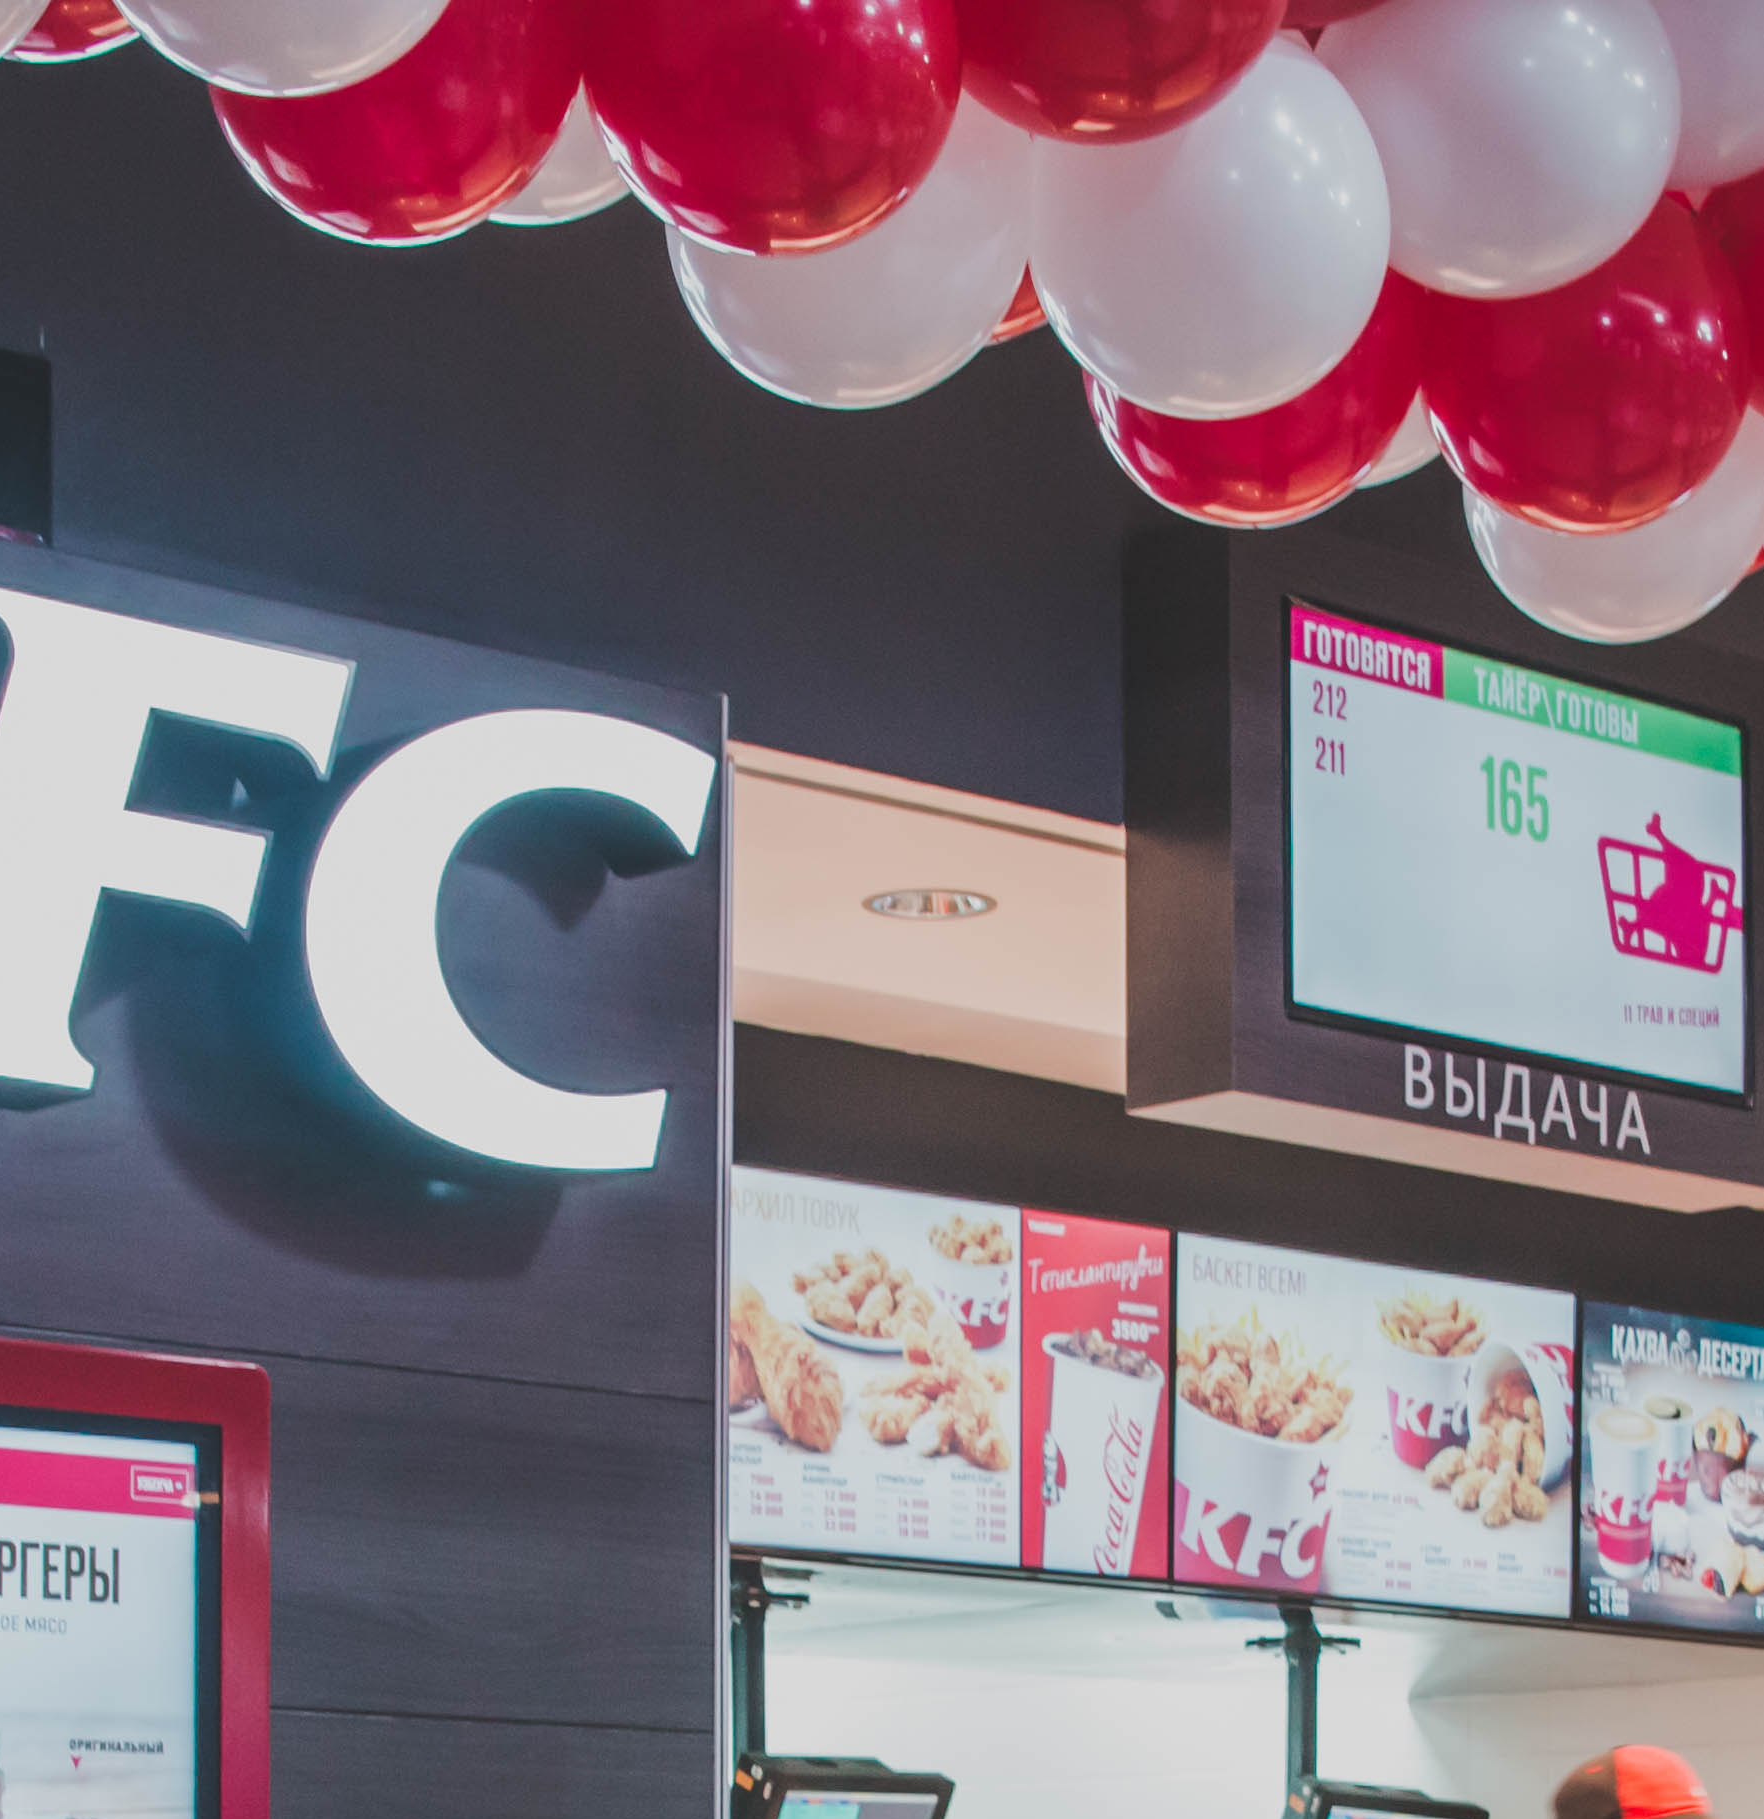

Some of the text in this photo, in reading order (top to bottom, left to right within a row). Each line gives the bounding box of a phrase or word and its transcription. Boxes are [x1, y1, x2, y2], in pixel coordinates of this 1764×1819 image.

[1302, 620, 1432, 691] ГОТОВЯТСЯ
[1312, 680, 1347, 721] 212
[1315, 737, 1347, 776] 211
[1481, 755, 1550, 842] 165
[1404, 1043, 1652, 1155] ВЫДАЧА
[1191, 1253, 1307, 1298] БАСКЕТ ВСЕМ!
[1180, 1498, 1333, 1581] KFC
[24, 1616, 68, 1635] МЯСО
[68, 1738, 165, 1755] ОРИГИНАЛЬНЫЙ
